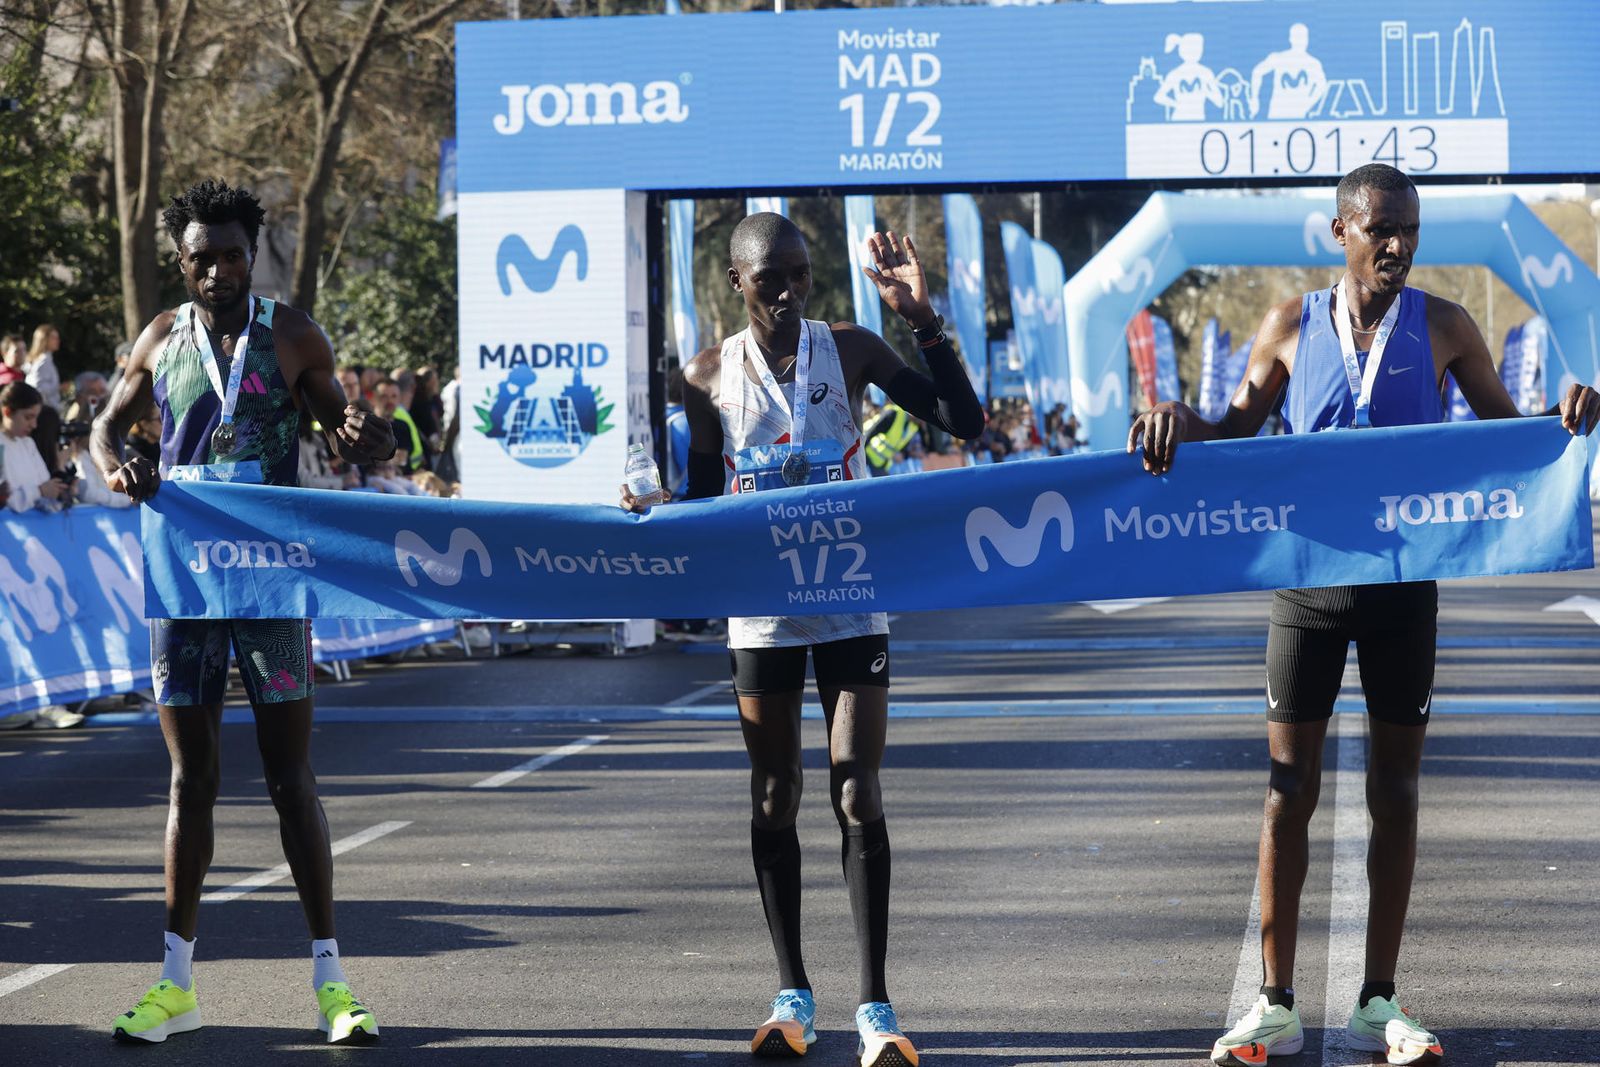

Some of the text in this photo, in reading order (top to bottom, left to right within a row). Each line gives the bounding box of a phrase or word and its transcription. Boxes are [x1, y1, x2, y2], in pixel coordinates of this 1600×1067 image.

[837, 28, 941, 51] Movistar
[837, 54, 942, 89] MAD
[838, 92, 942, 147] 1/2
[839, 148, 942, 171] MARATÓN
[1200, 125, 1438, 174] 01:01:43
[479, 342, 609, 370] MADRID
[766, 498, 856, 521] Movistar
[1104, 499, 1296, 542] Movistar
[770, 517, 862, 547] MAD
[514, 546, 690, 578] Movistar
[778, 542, 873, 586] 1/2
[788, 585, 875, 604] MARATÓN
